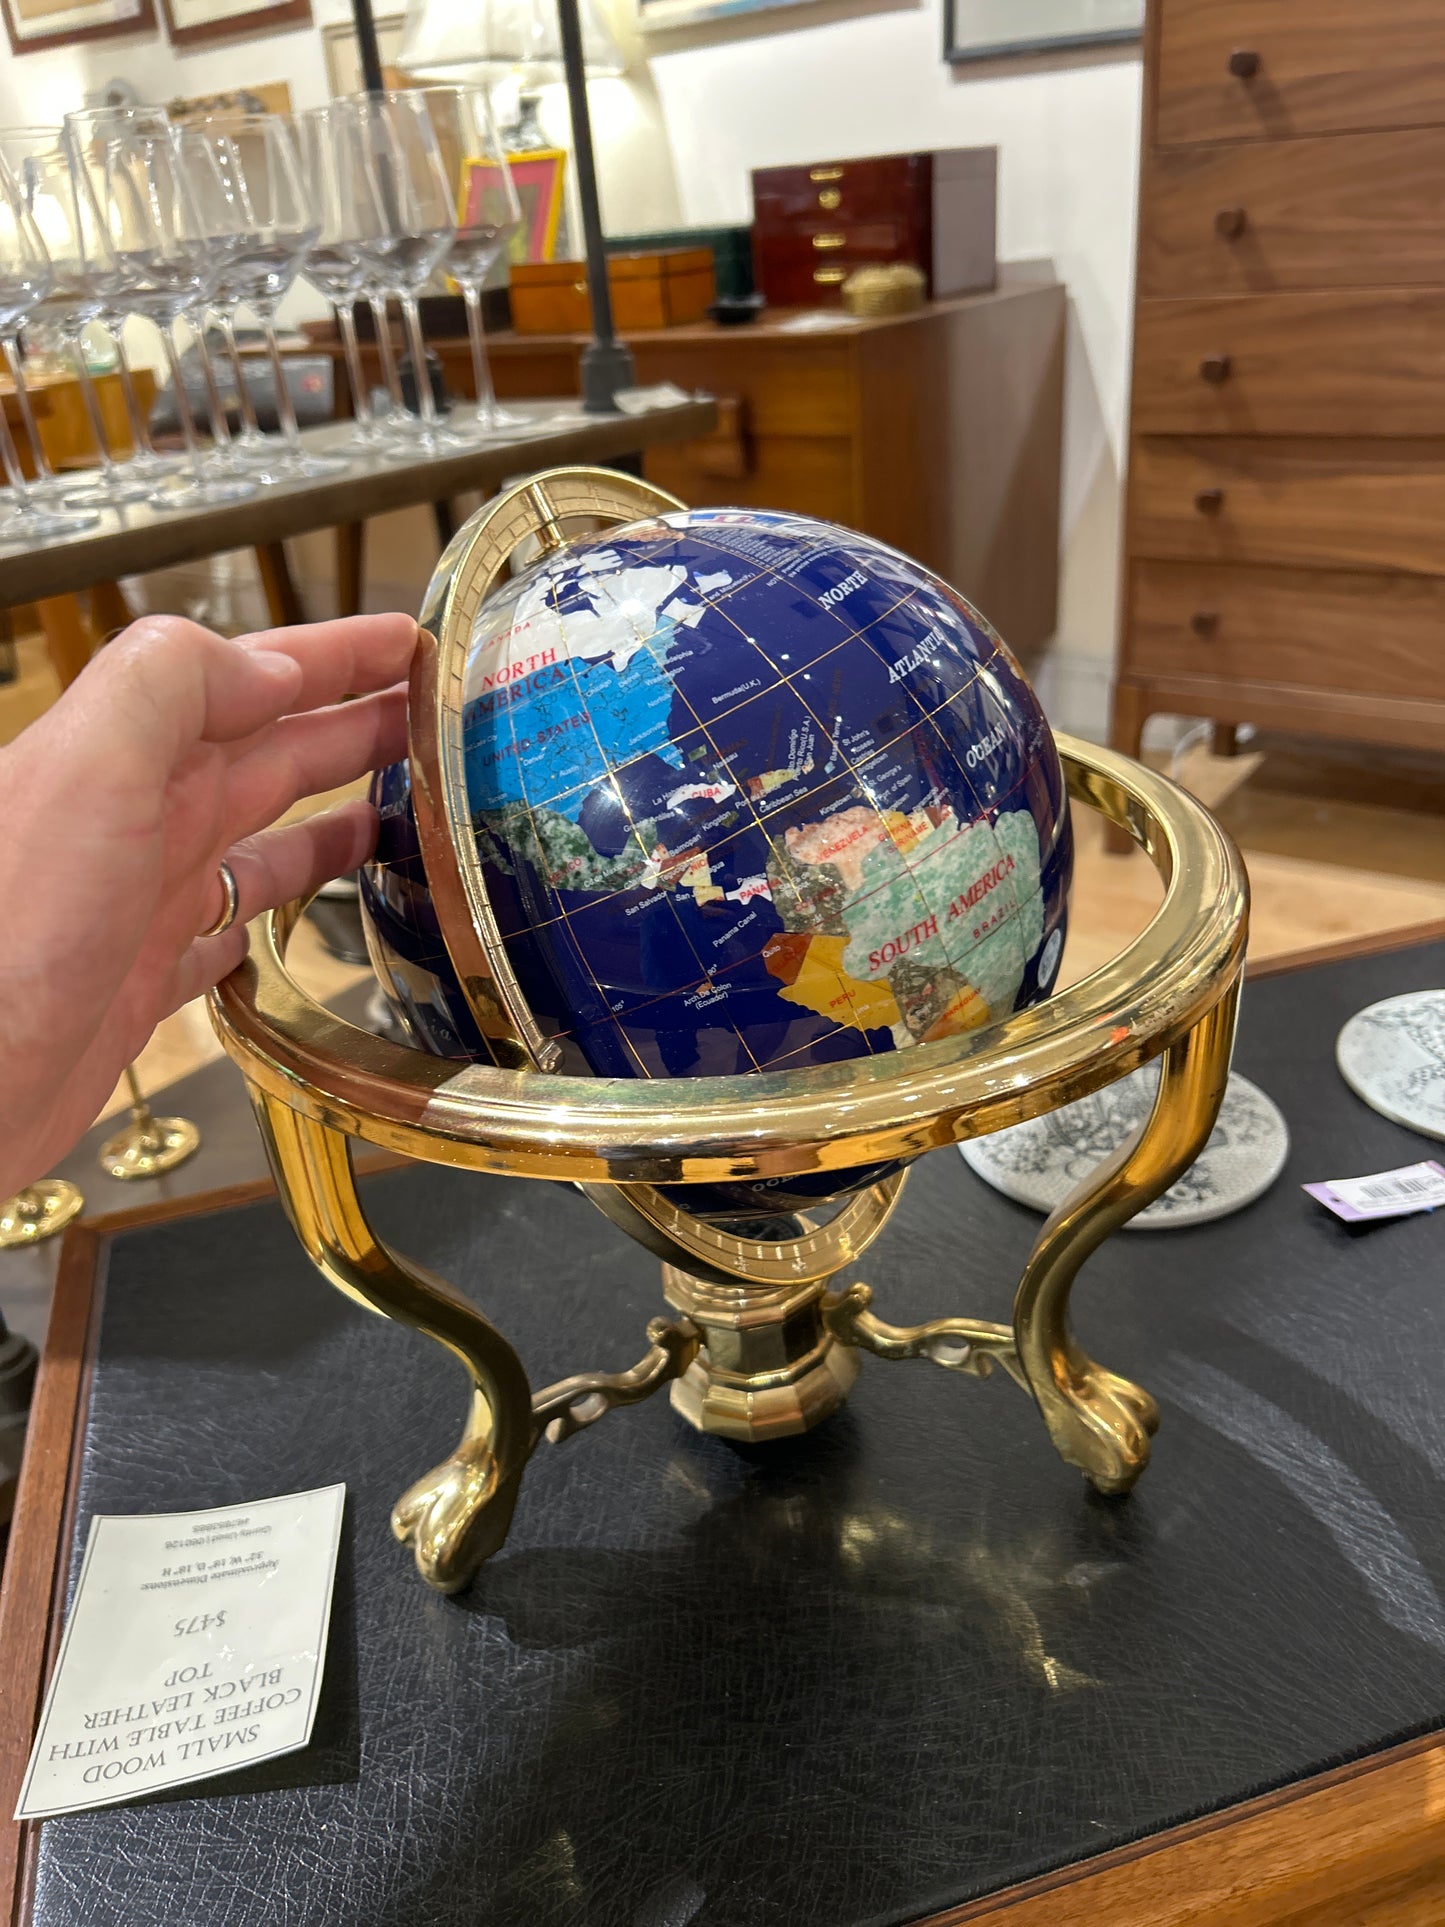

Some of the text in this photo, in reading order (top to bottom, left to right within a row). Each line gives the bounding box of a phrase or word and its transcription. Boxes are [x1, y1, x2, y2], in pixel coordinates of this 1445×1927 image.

[817, 570, 868, 610] NORTH
[481, 647, 557, 691] NORTH
[888, 626, 945, 684] ATLANTIC
[537, 711, 591, 744] STATES
[966, 721, 1006, 769] OCEAN
[691, 786, 722, 801] CUBA
[816, 825, 869, 862] VENEZUELA
[868, 914, 940, 972] SOUTH
[946, 853, 1016, 922] AMERICA
[972, 901, 1016, 940] BRAZIL
[829, 988, 856, 1009] PERU
[174, 1610, 227, 1637] $475
[164, 1662, 214, 1687] TOP
[83, 1667, 285, 1730] BLACK LEATHER
[48, 1687, 302, 1762] COFFEE TABLE WITH
[82, 1723, 261, 1784] SMALL WOOD
